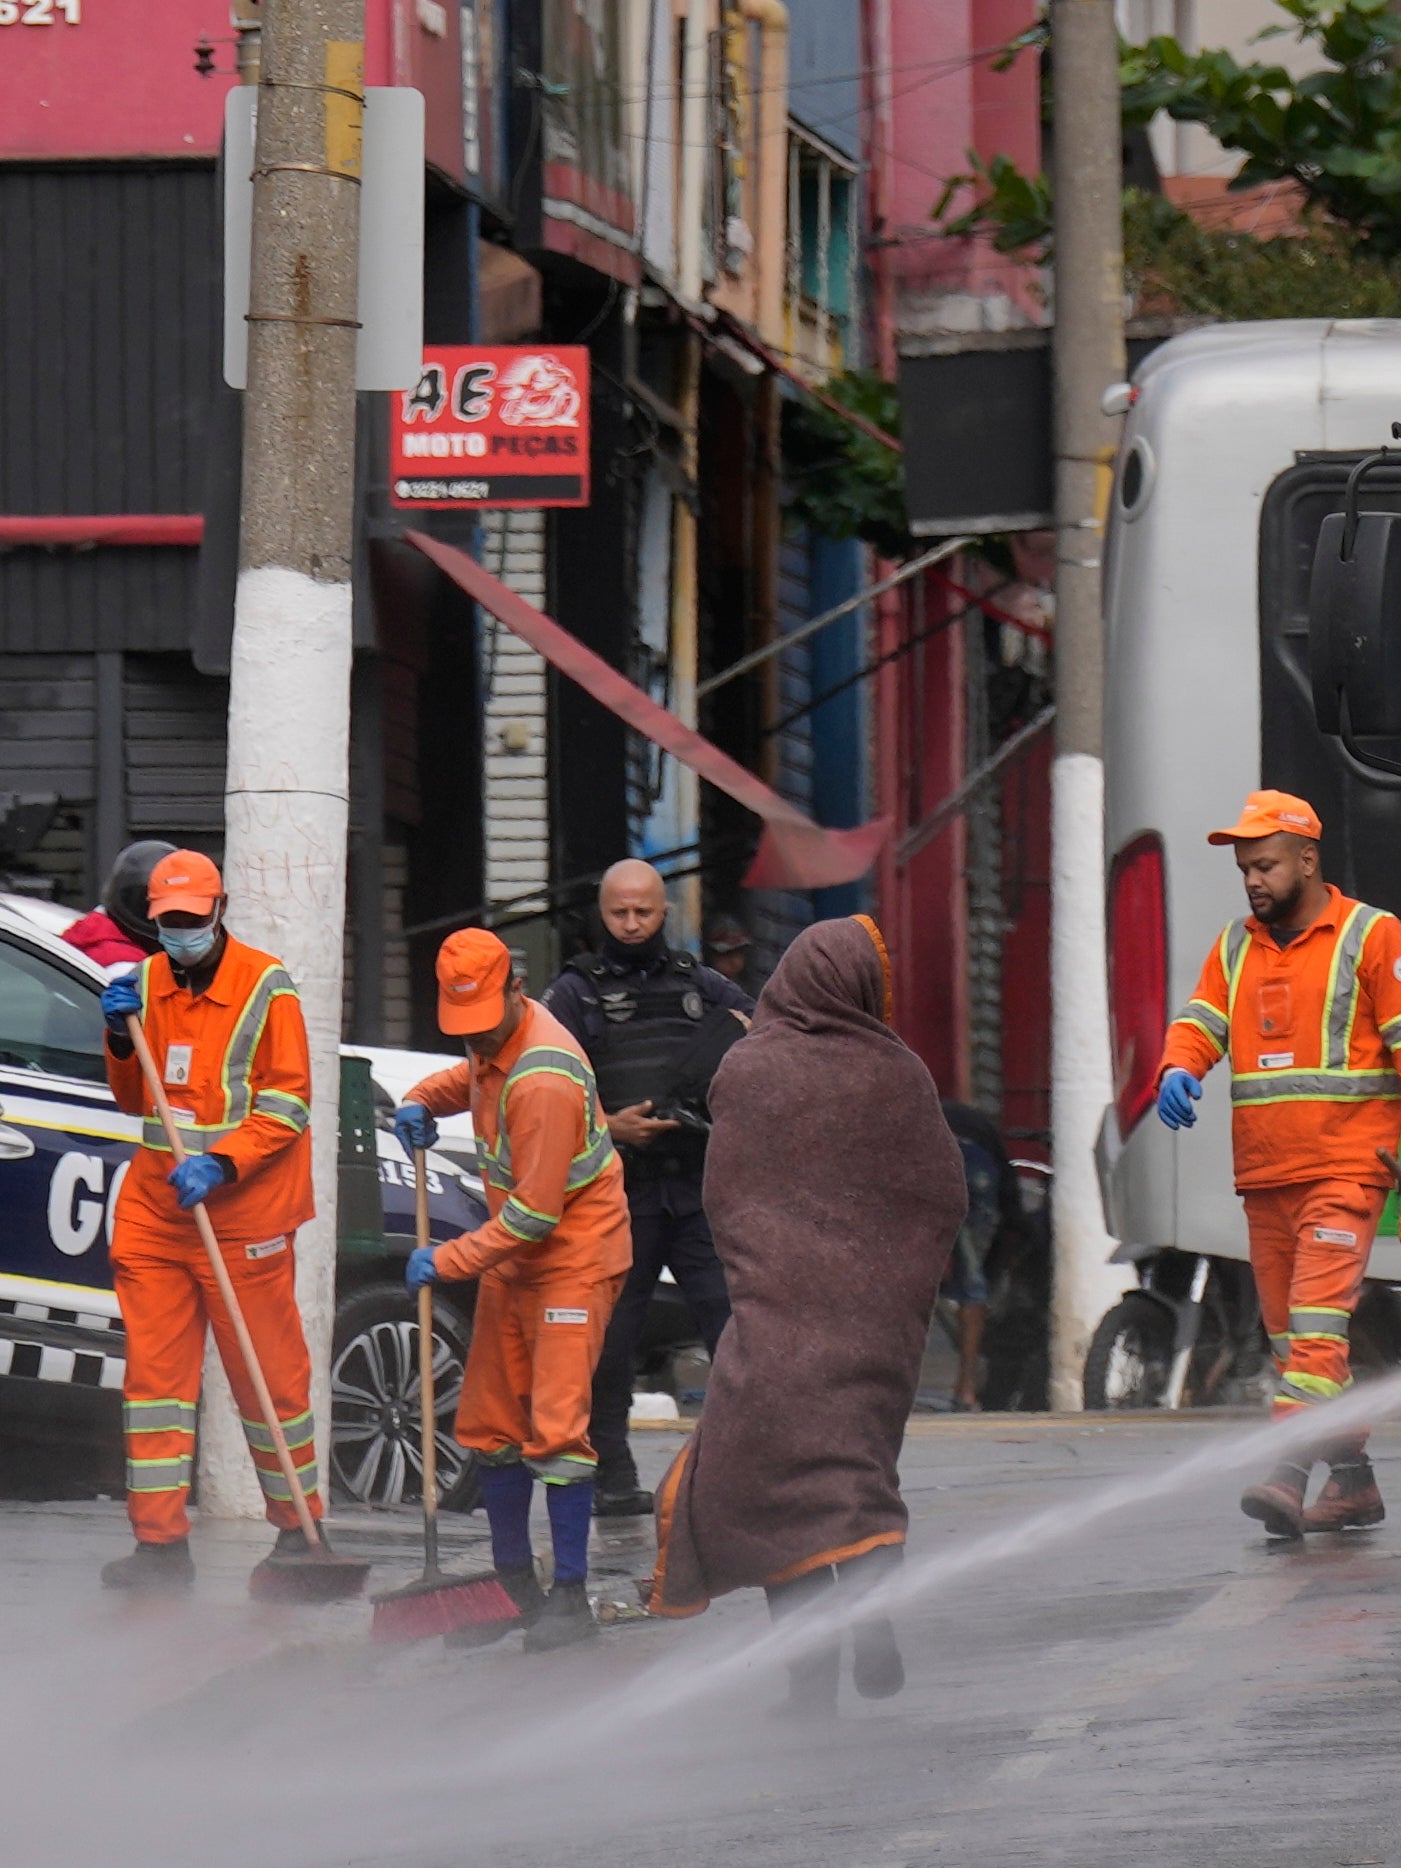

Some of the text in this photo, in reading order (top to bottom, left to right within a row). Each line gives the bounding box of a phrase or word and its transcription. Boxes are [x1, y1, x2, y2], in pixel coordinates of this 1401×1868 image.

[403, 432, 578, 458] MOTO PEÇAS
[47, 1151, 131, 1256] G
